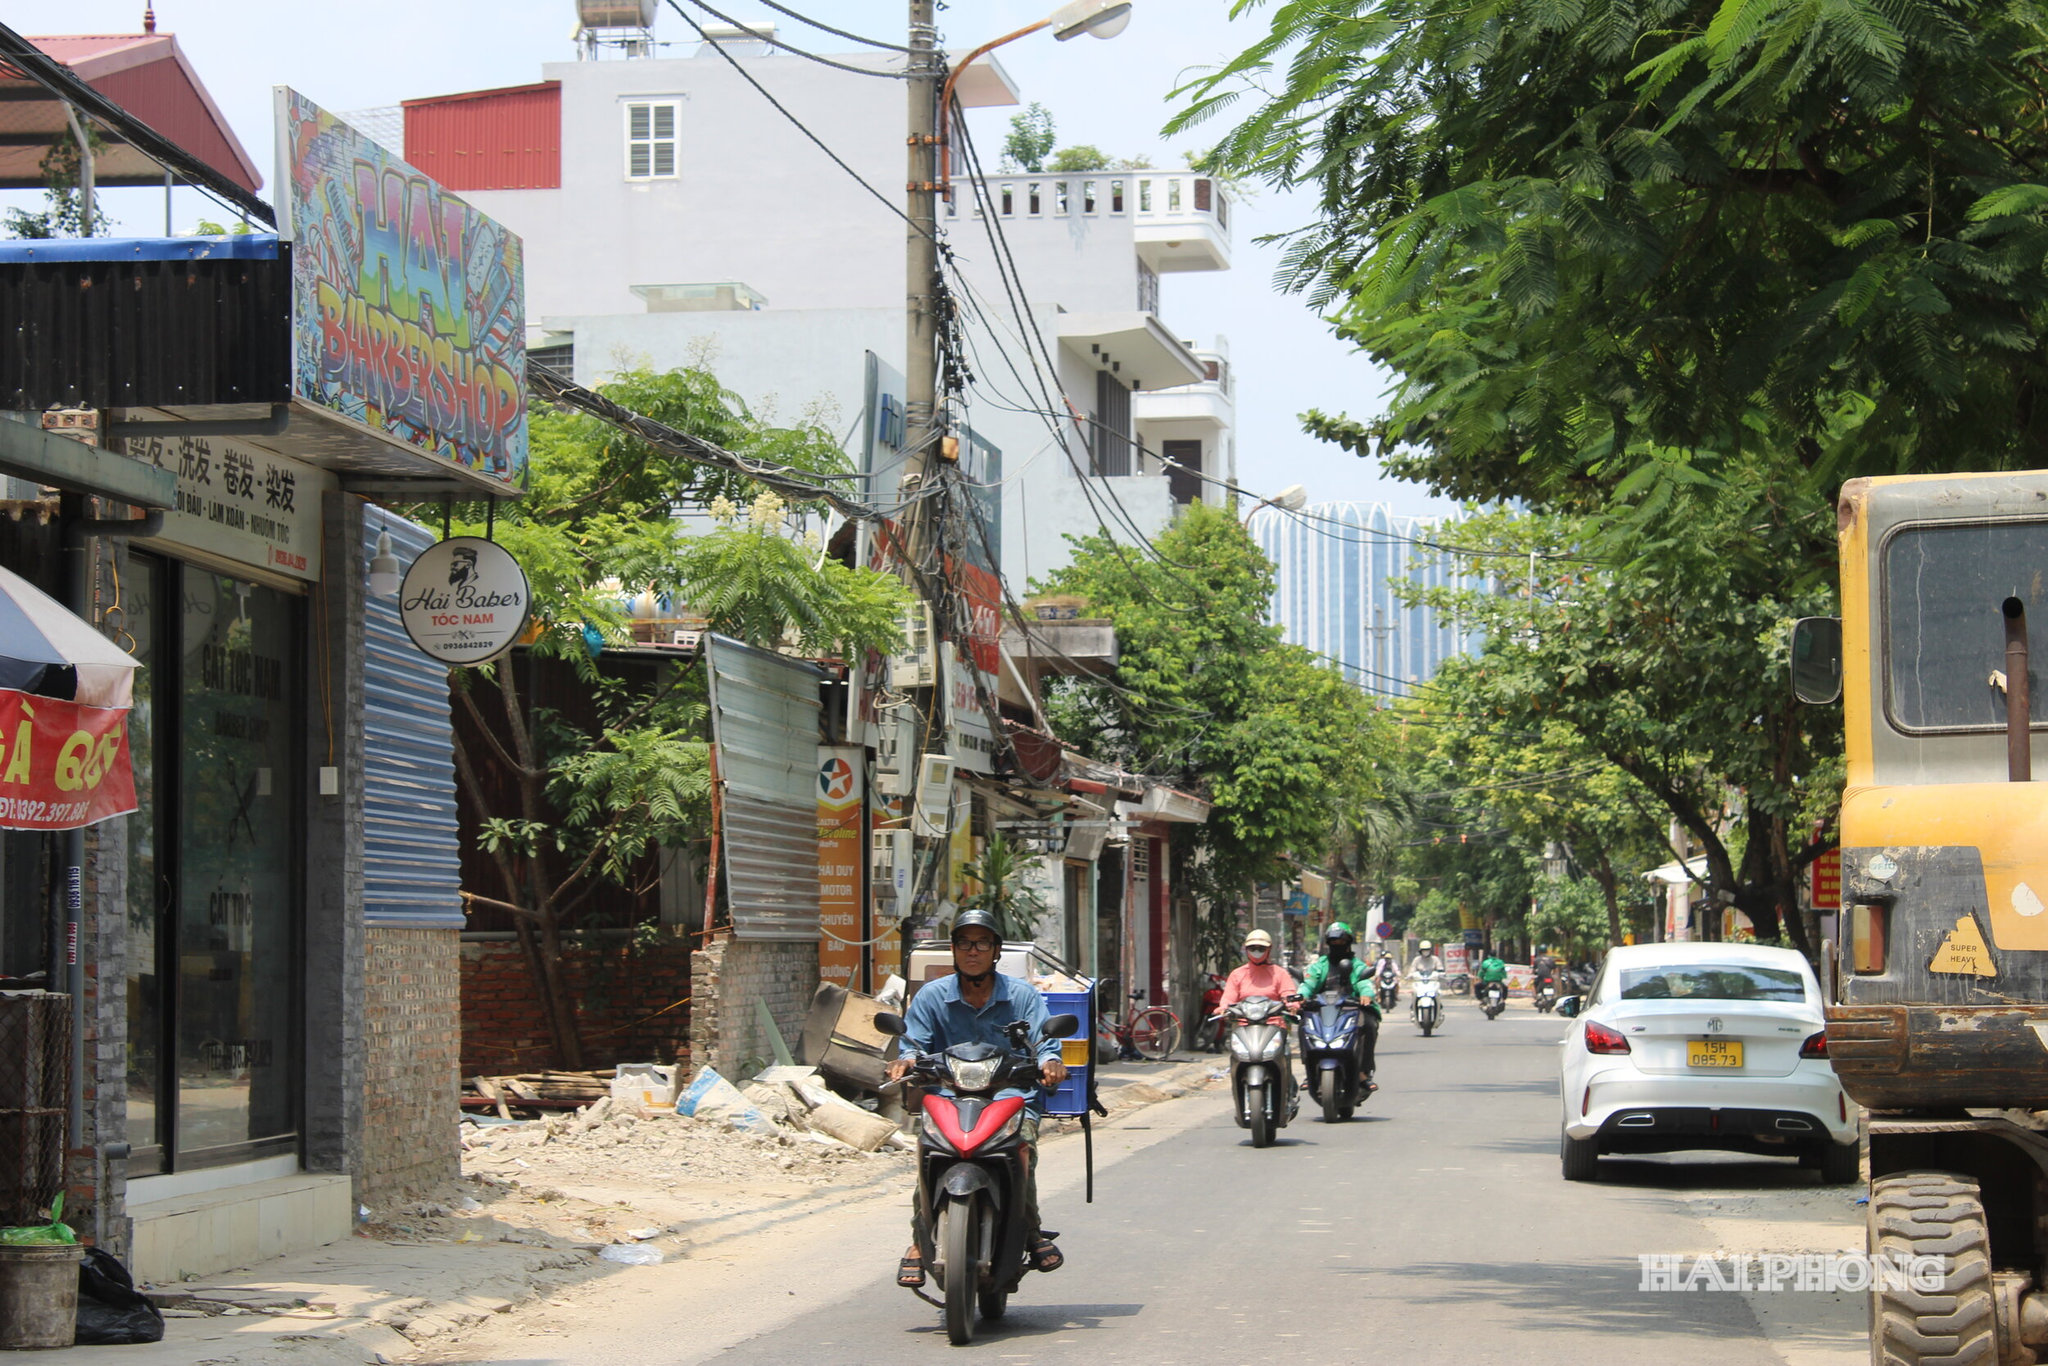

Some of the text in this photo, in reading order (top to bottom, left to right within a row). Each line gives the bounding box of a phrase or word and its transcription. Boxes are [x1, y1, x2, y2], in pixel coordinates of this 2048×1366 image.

[431, 612, 494, 626] TÓC NAM
[836, 864, 854, 876] DUY
[820, 884, 853, 896] MOTOR
[1950, 944, 1977, 953] SUPER
[1950, 955, 1976, 963] HEAVY
[1703, 1042, 1727, 1054] 15H
[1692, 1055, 1737, 1066] 085.73
